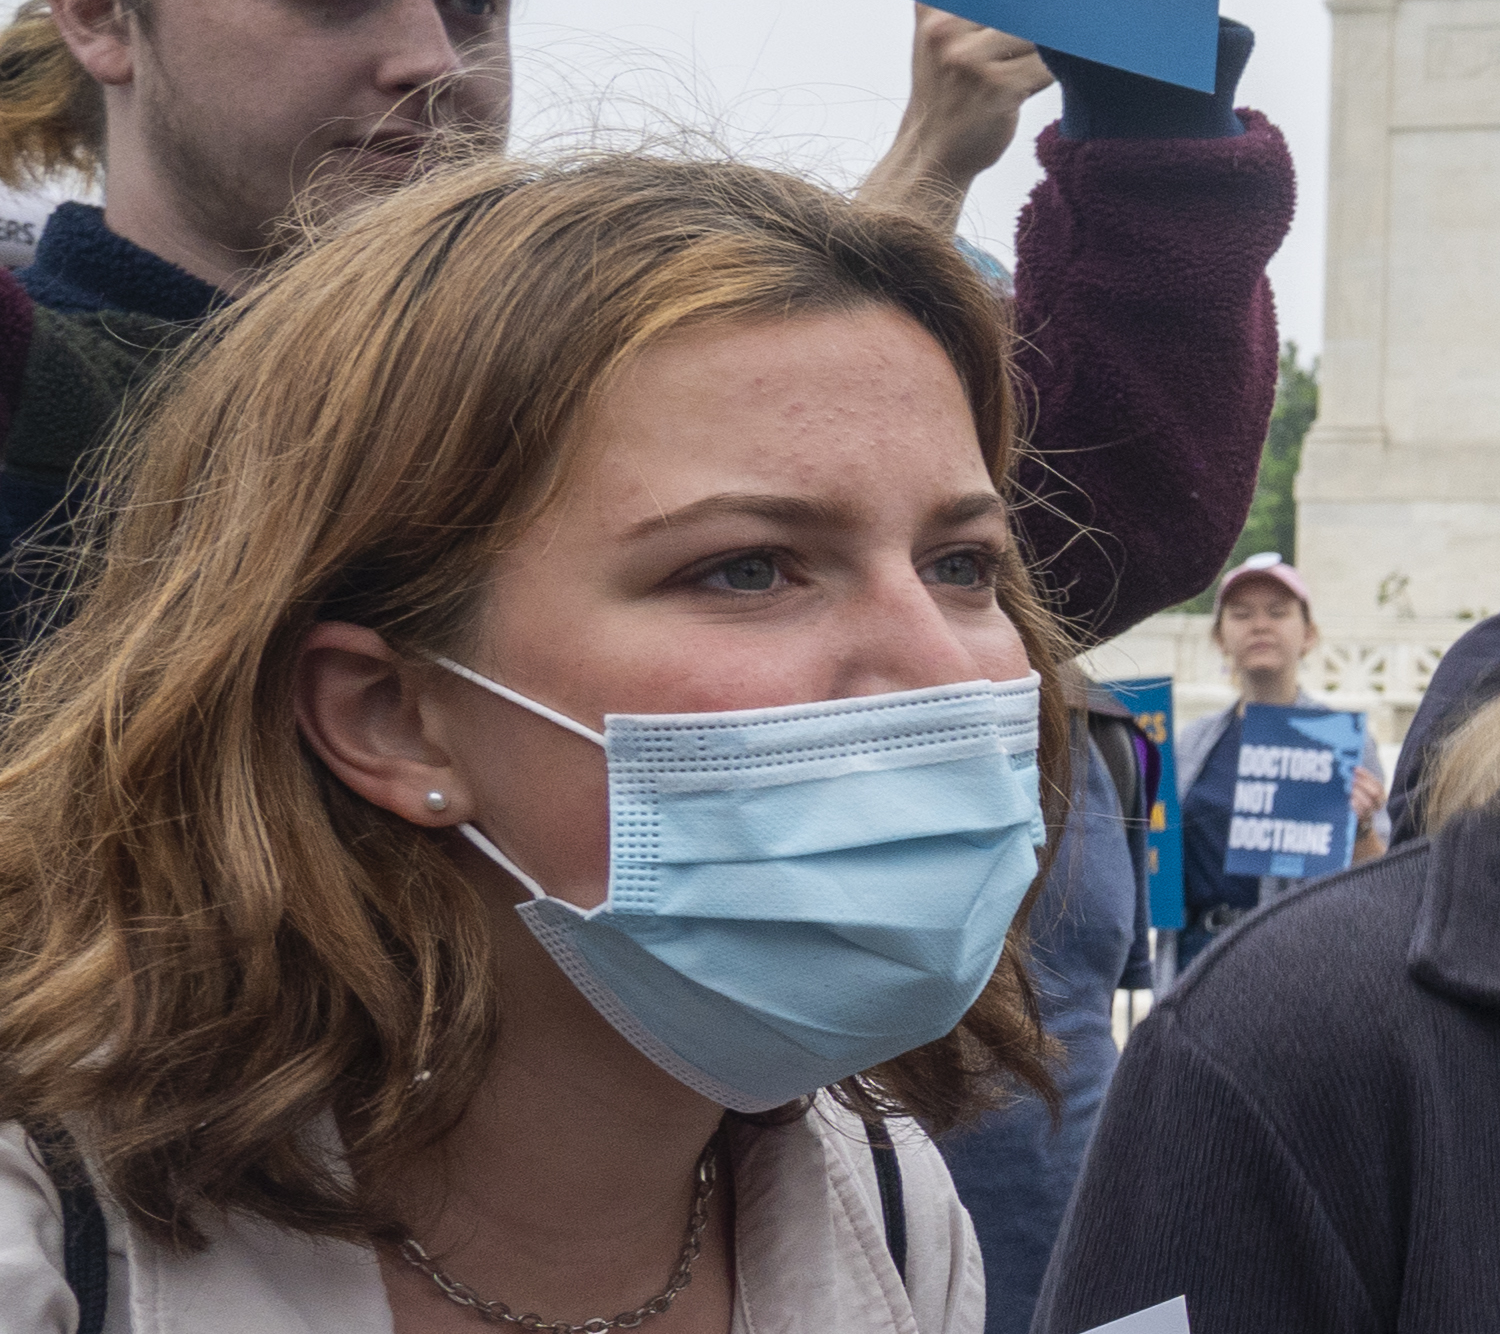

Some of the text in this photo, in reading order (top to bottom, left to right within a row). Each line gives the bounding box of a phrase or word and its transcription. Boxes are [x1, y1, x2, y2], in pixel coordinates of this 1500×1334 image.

[1238, 745, 1334, 783] DOCTORS
[1235, 782, 1278, 813] NOT
[1229, 818, 1333, 856] DOCTRINE
